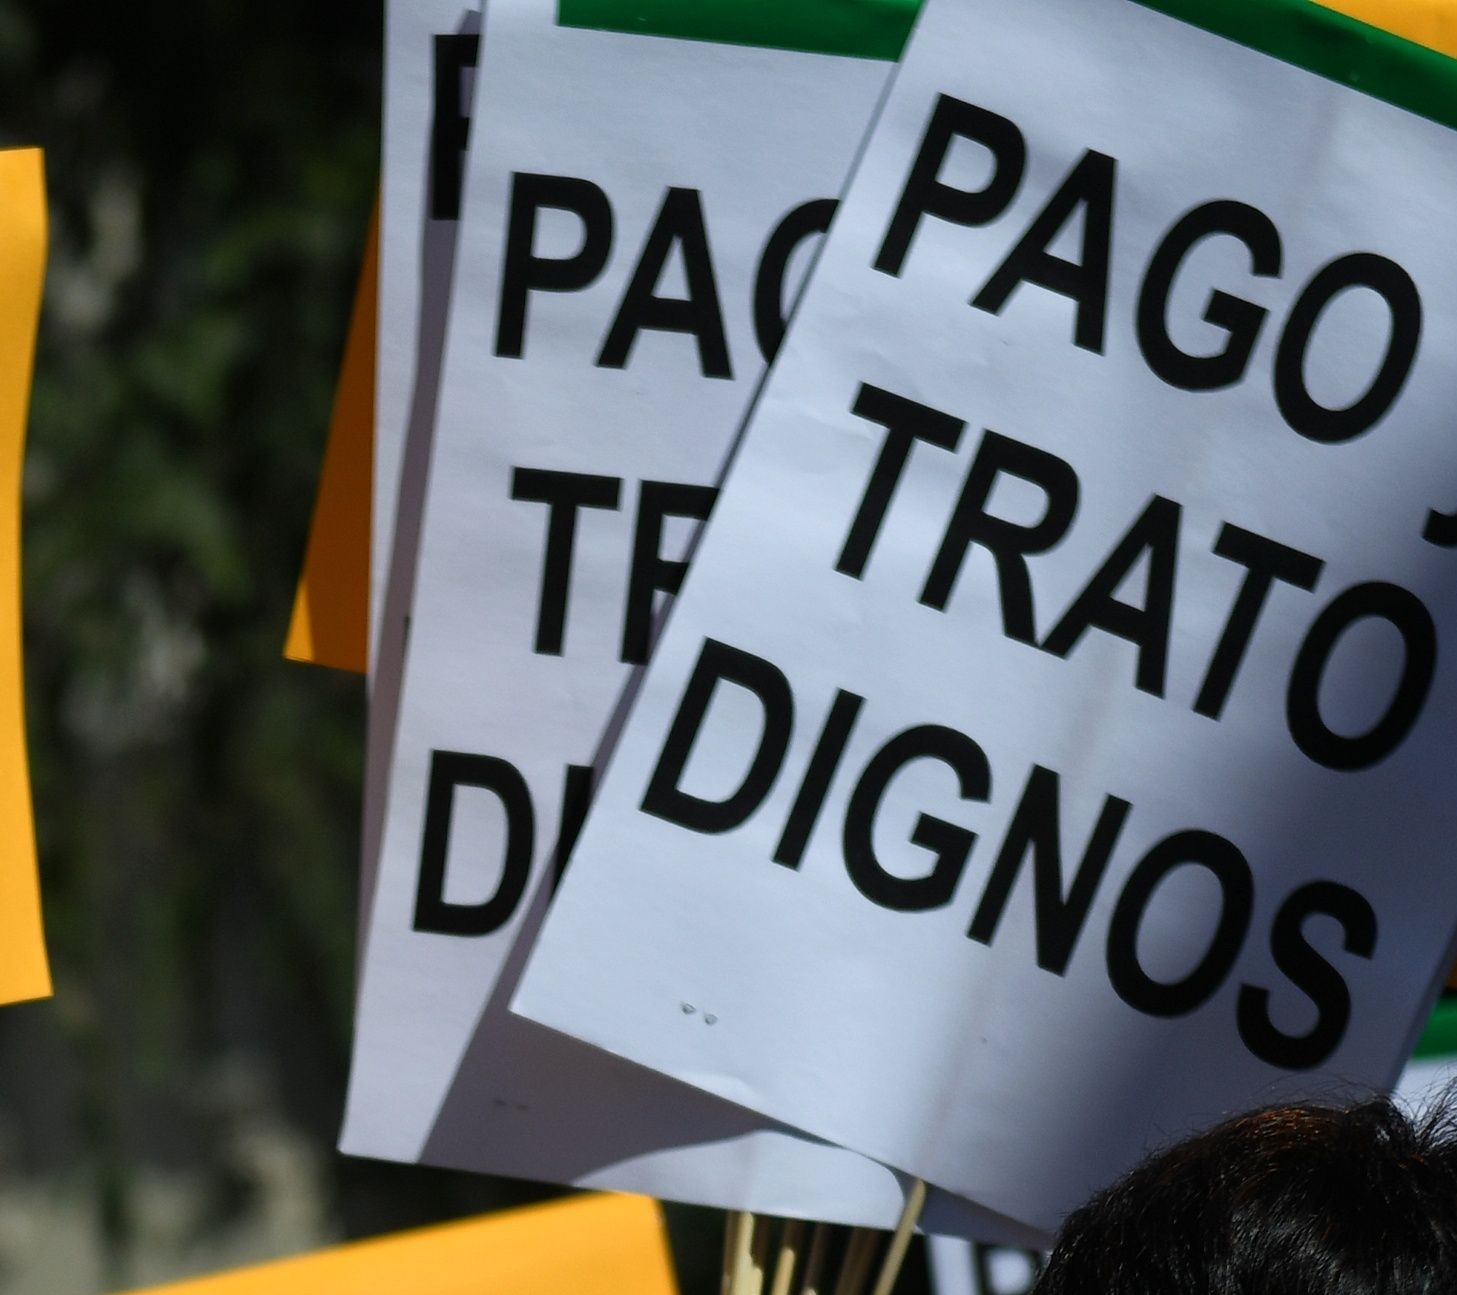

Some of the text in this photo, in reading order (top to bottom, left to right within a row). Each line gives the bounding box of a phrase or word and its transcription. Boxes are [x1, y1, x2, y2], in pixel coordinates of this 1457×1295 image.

[872, 92, 1421, 446] PAGO
[833, 382, 1438, 774] TRATO
[637, 637, 1378, 1072] DIGNOS
